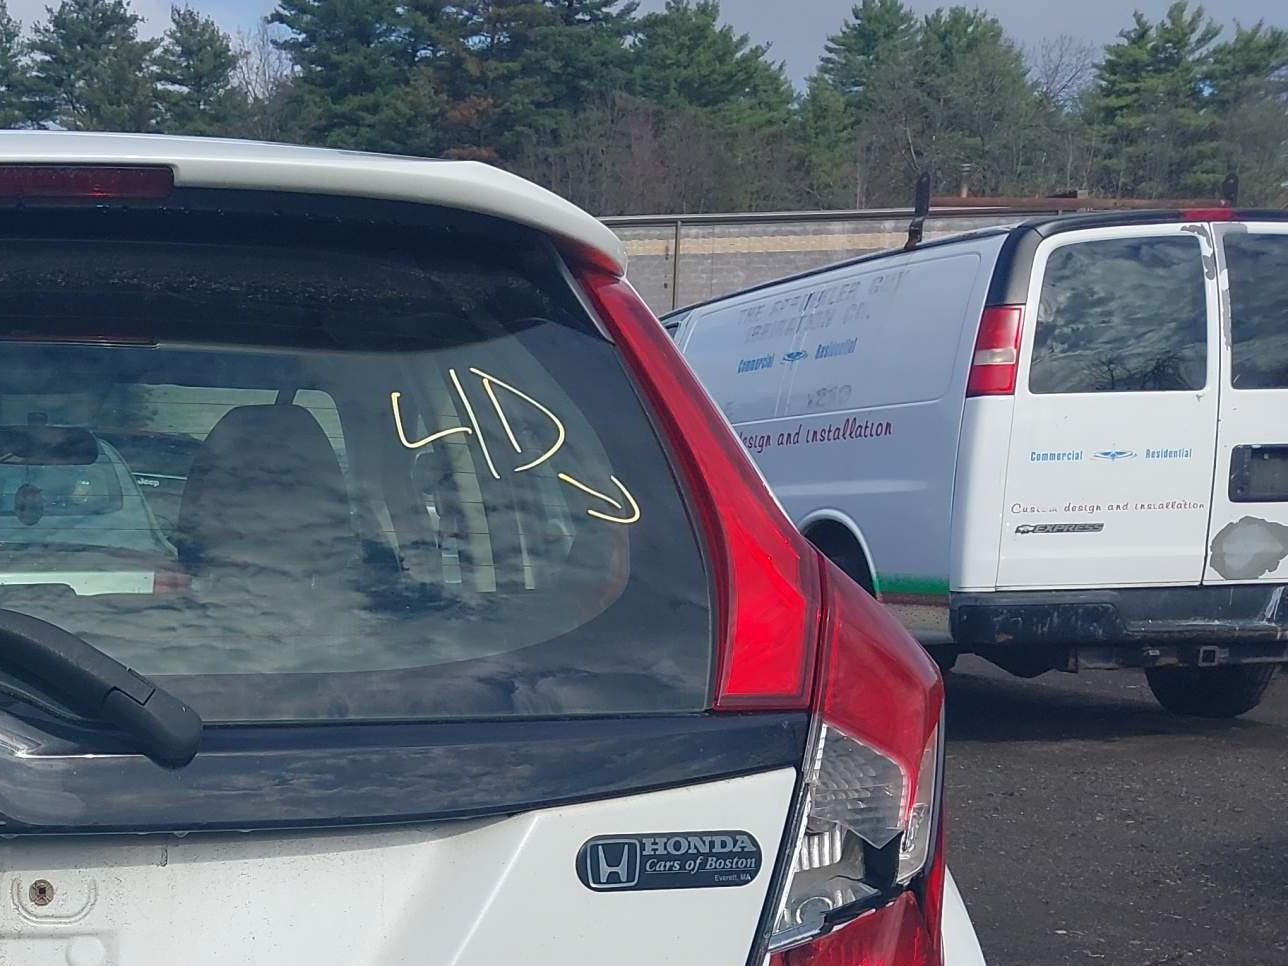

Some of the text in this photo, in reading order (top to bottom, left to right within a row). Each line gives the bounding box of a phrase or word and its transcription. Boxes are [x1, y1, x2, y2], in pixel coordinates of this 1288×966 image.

[777, 423, 803, 446] and
[806, 417, 893, 444] installation
[1030, 448, 1193, 462] Commercial Residential
[1064, 501, 1102, 514] design
[1107, 501, 1129, 511] and
[1033, 523, 1104, 534] EXPRESS
[642, 834, 757, 856] HONDA
[645, 855, 756, 875] Cars of Boston
